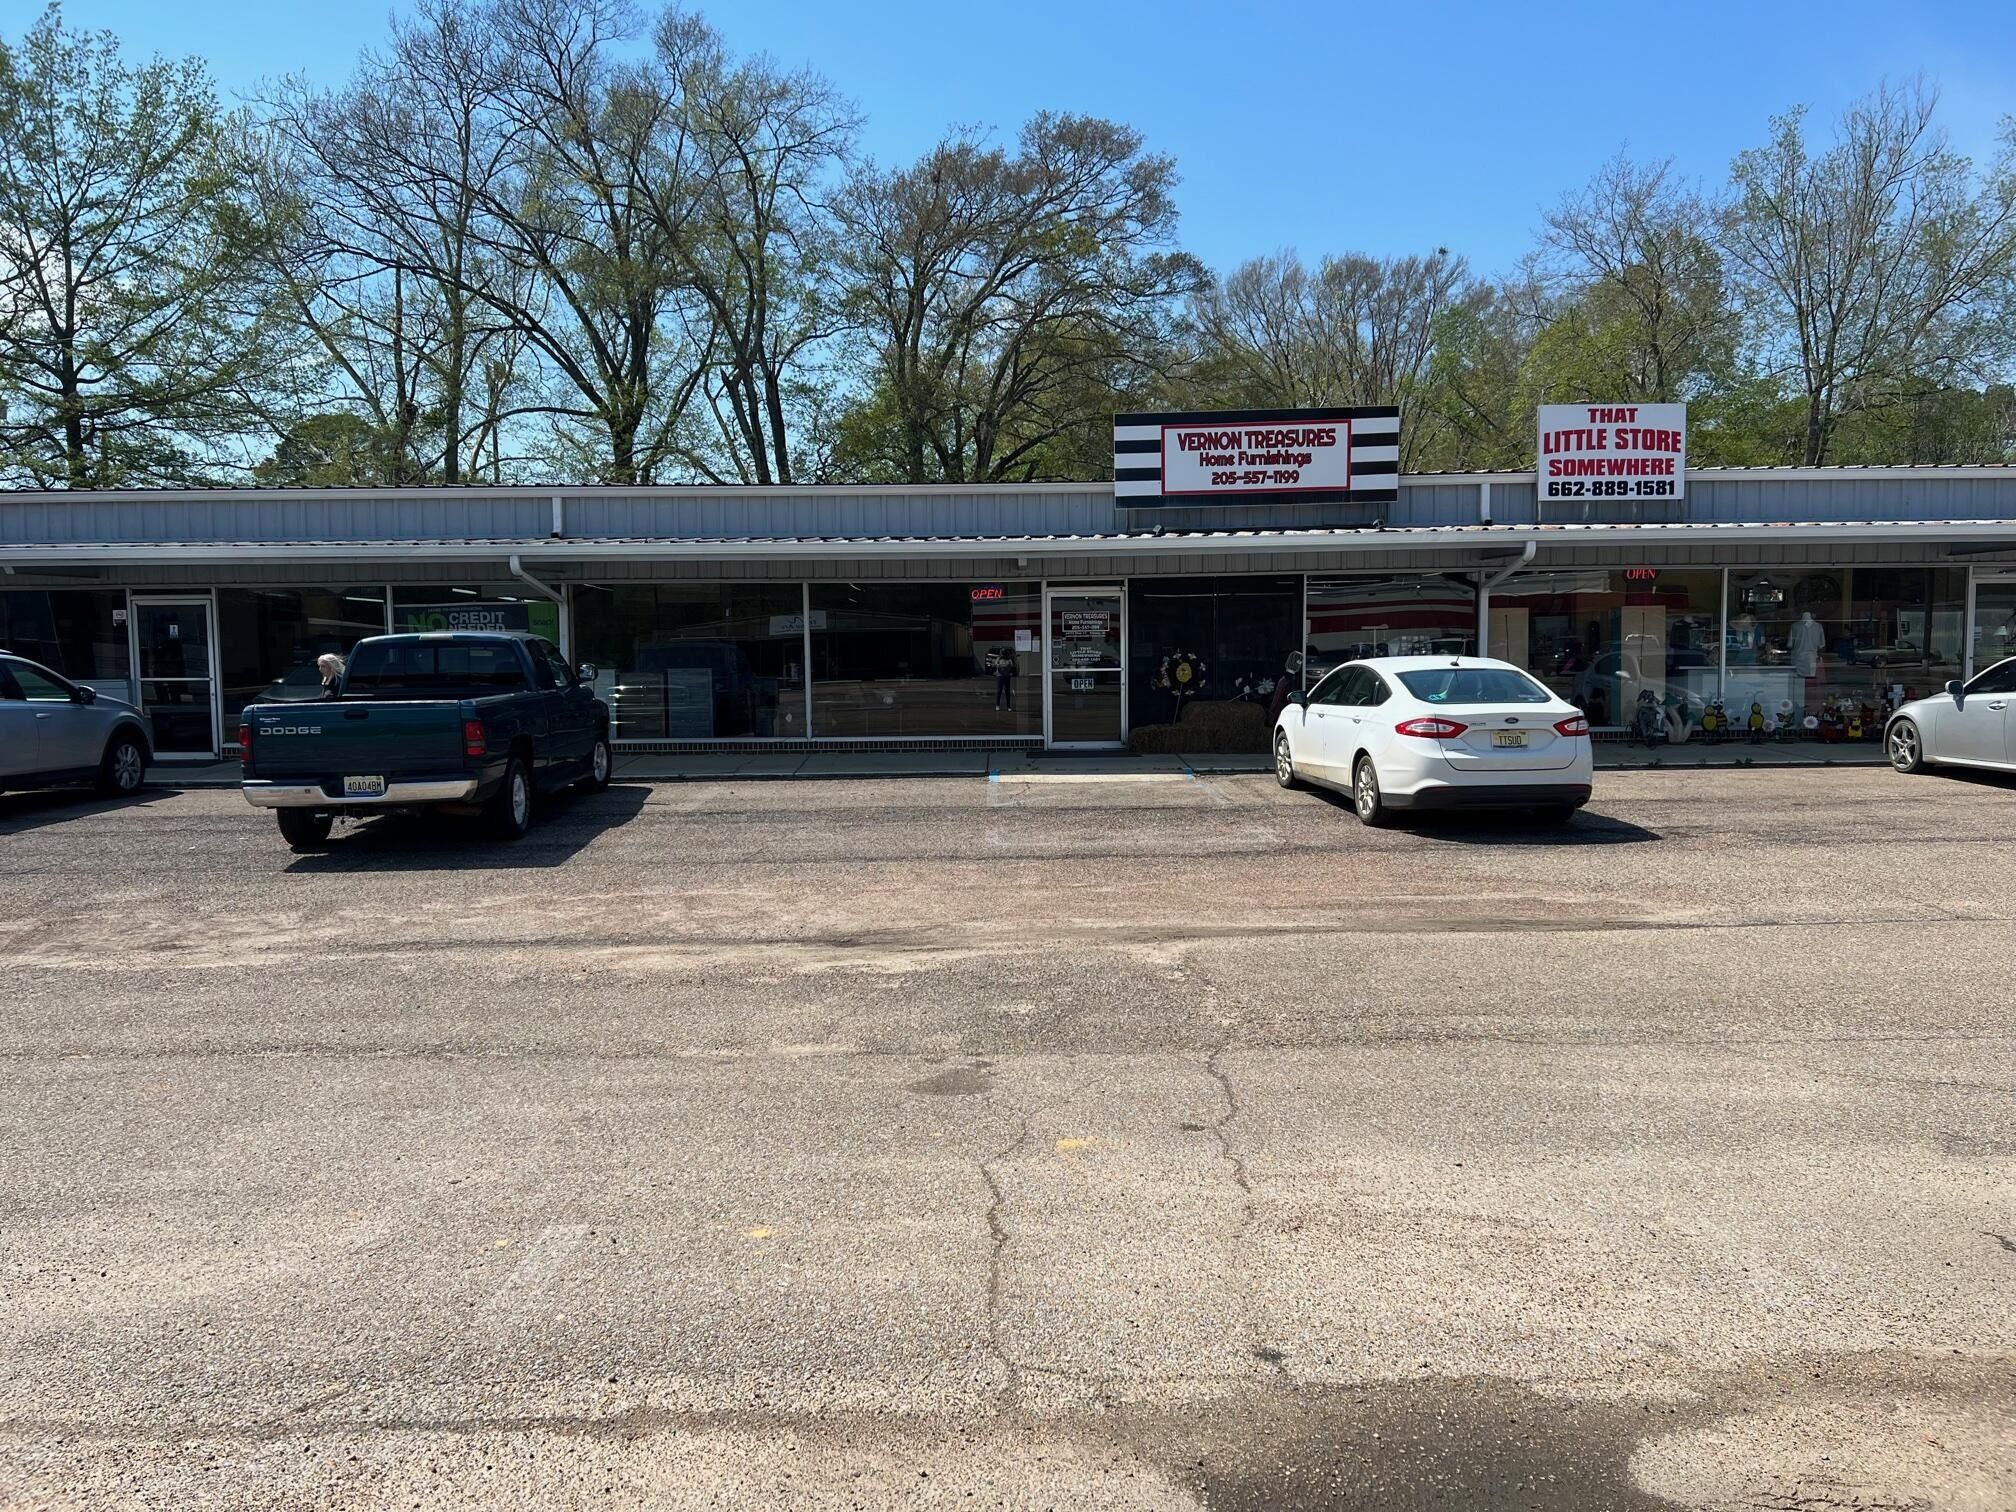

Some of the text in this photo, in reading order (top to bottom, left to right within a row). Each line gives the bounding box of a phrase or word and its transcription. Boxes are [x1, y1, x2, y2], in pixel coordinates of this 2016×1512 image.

[1587, 408, 1638, 423] THAT
[1177, 428, 1336, 451] VERNON TREASURES
[1543, 428, 1682, 455] LITTLE STORE
[1199, 450, 1312, 468] Home Furnishings
[1548, 458, 1675, 477] SOMEWHERE
[1211, 470, 1300, 485] 205-557-1199
[1548, 480, 1675, 497] 662-889-1581
[1626, 568, 1657, 579] OPEN
[971, 589, 1003, 600] OPEN
[408, 611, 448, 632] NO
[449, 611, 505, 624] CREDIT
[450, 623, 506, 632] NEEDED
[1073, 680, 1093, 689] OPEN
[260, 726, 322, 735] DODGE
